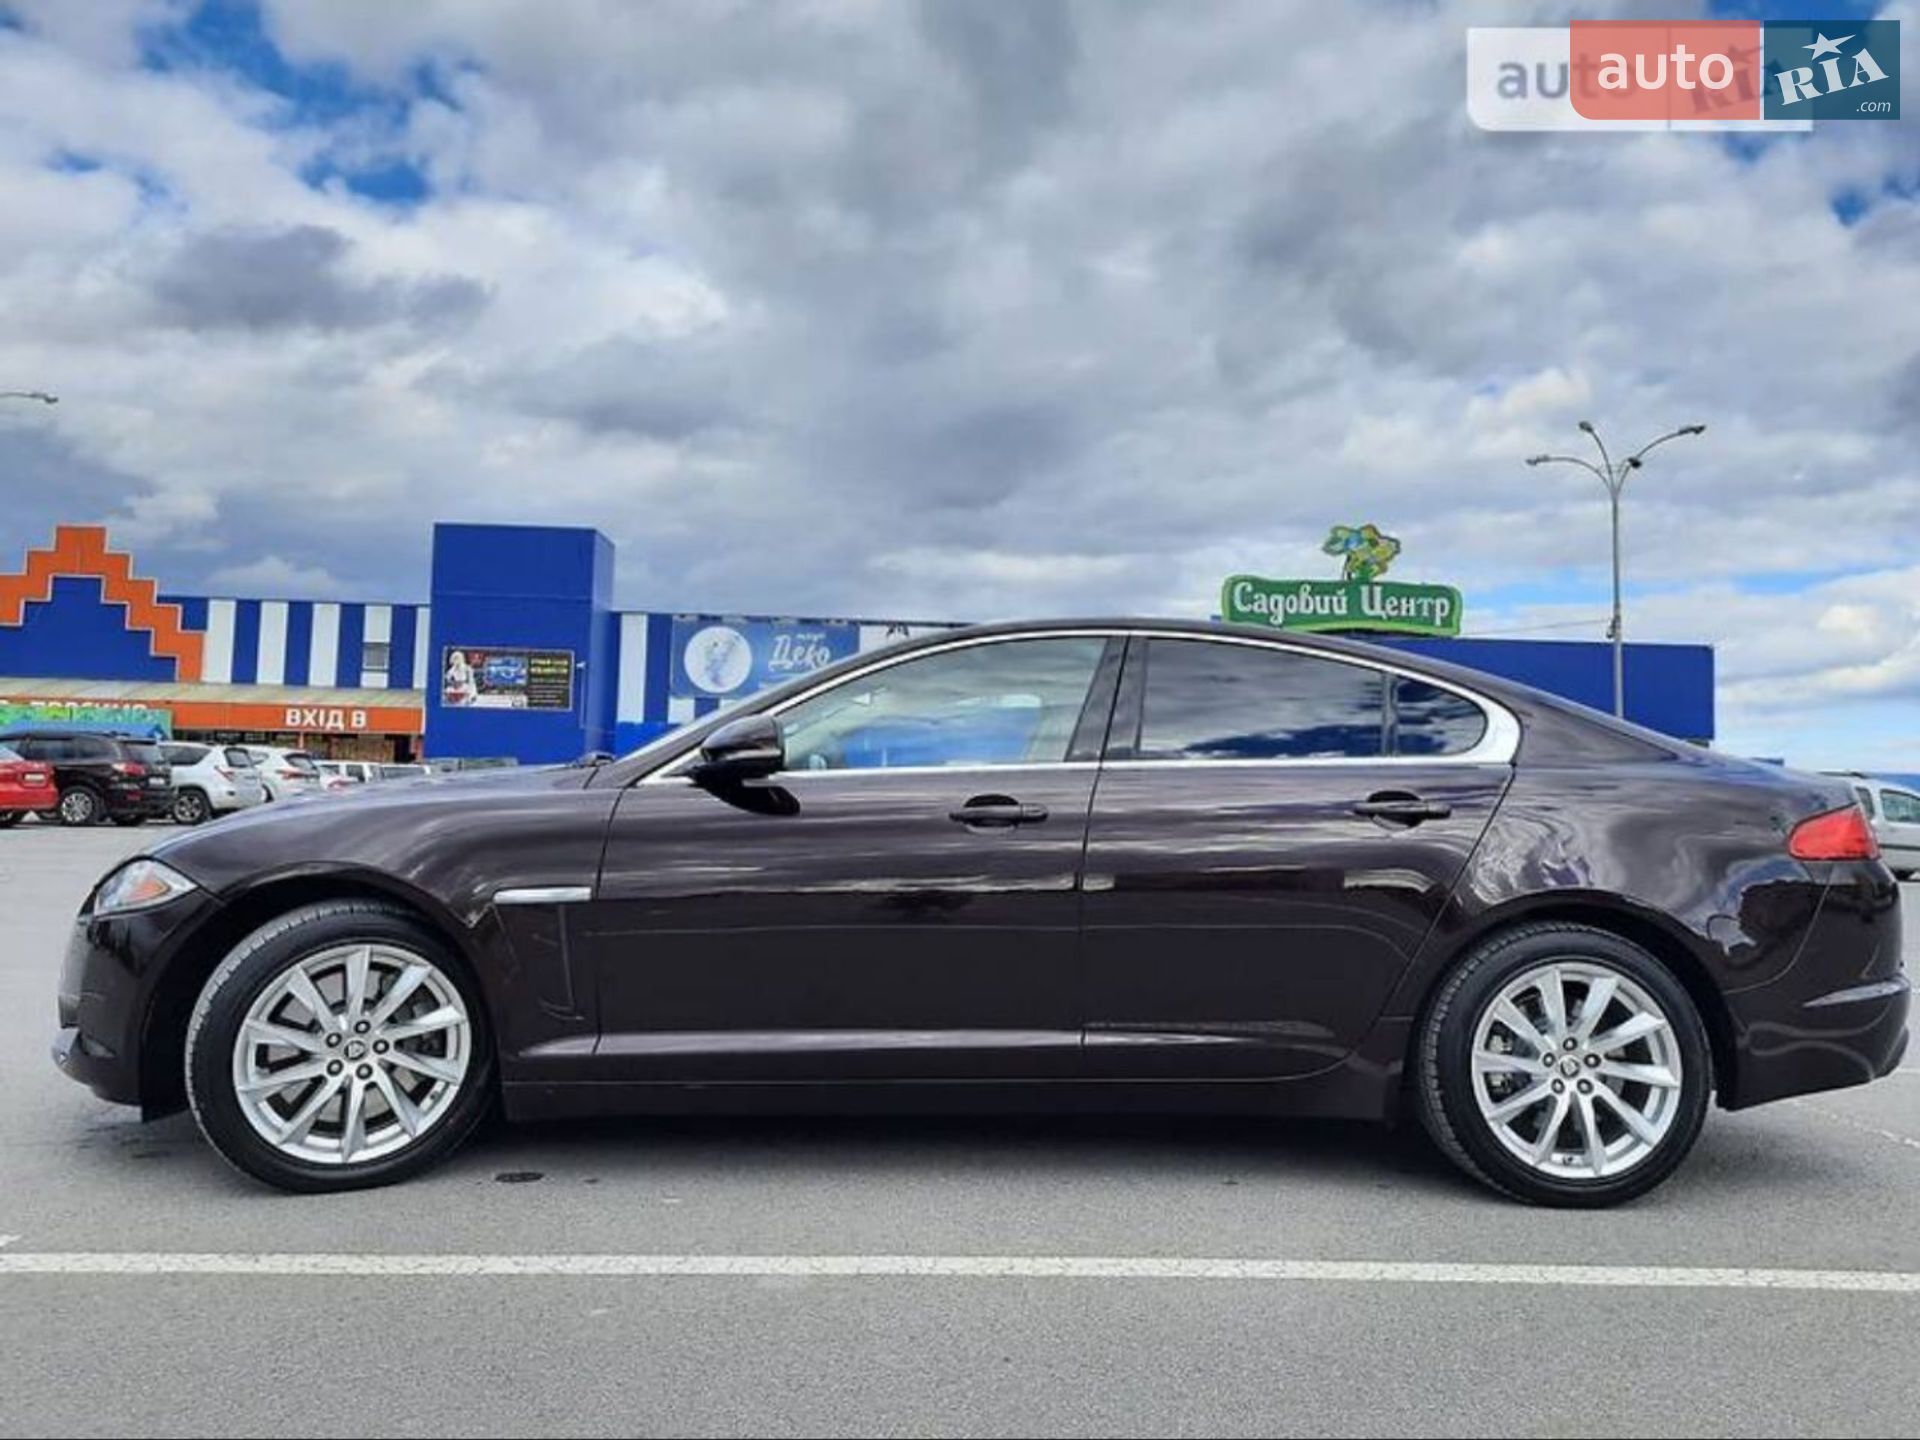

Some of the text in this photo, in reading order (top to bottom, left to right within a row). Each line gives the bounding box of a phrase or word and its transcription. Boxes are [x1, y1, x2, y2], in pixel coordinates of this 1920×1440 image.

[1233, 581, 1450, 626] Садовий Центр
[285, 708, 344, 731] ВХІД
